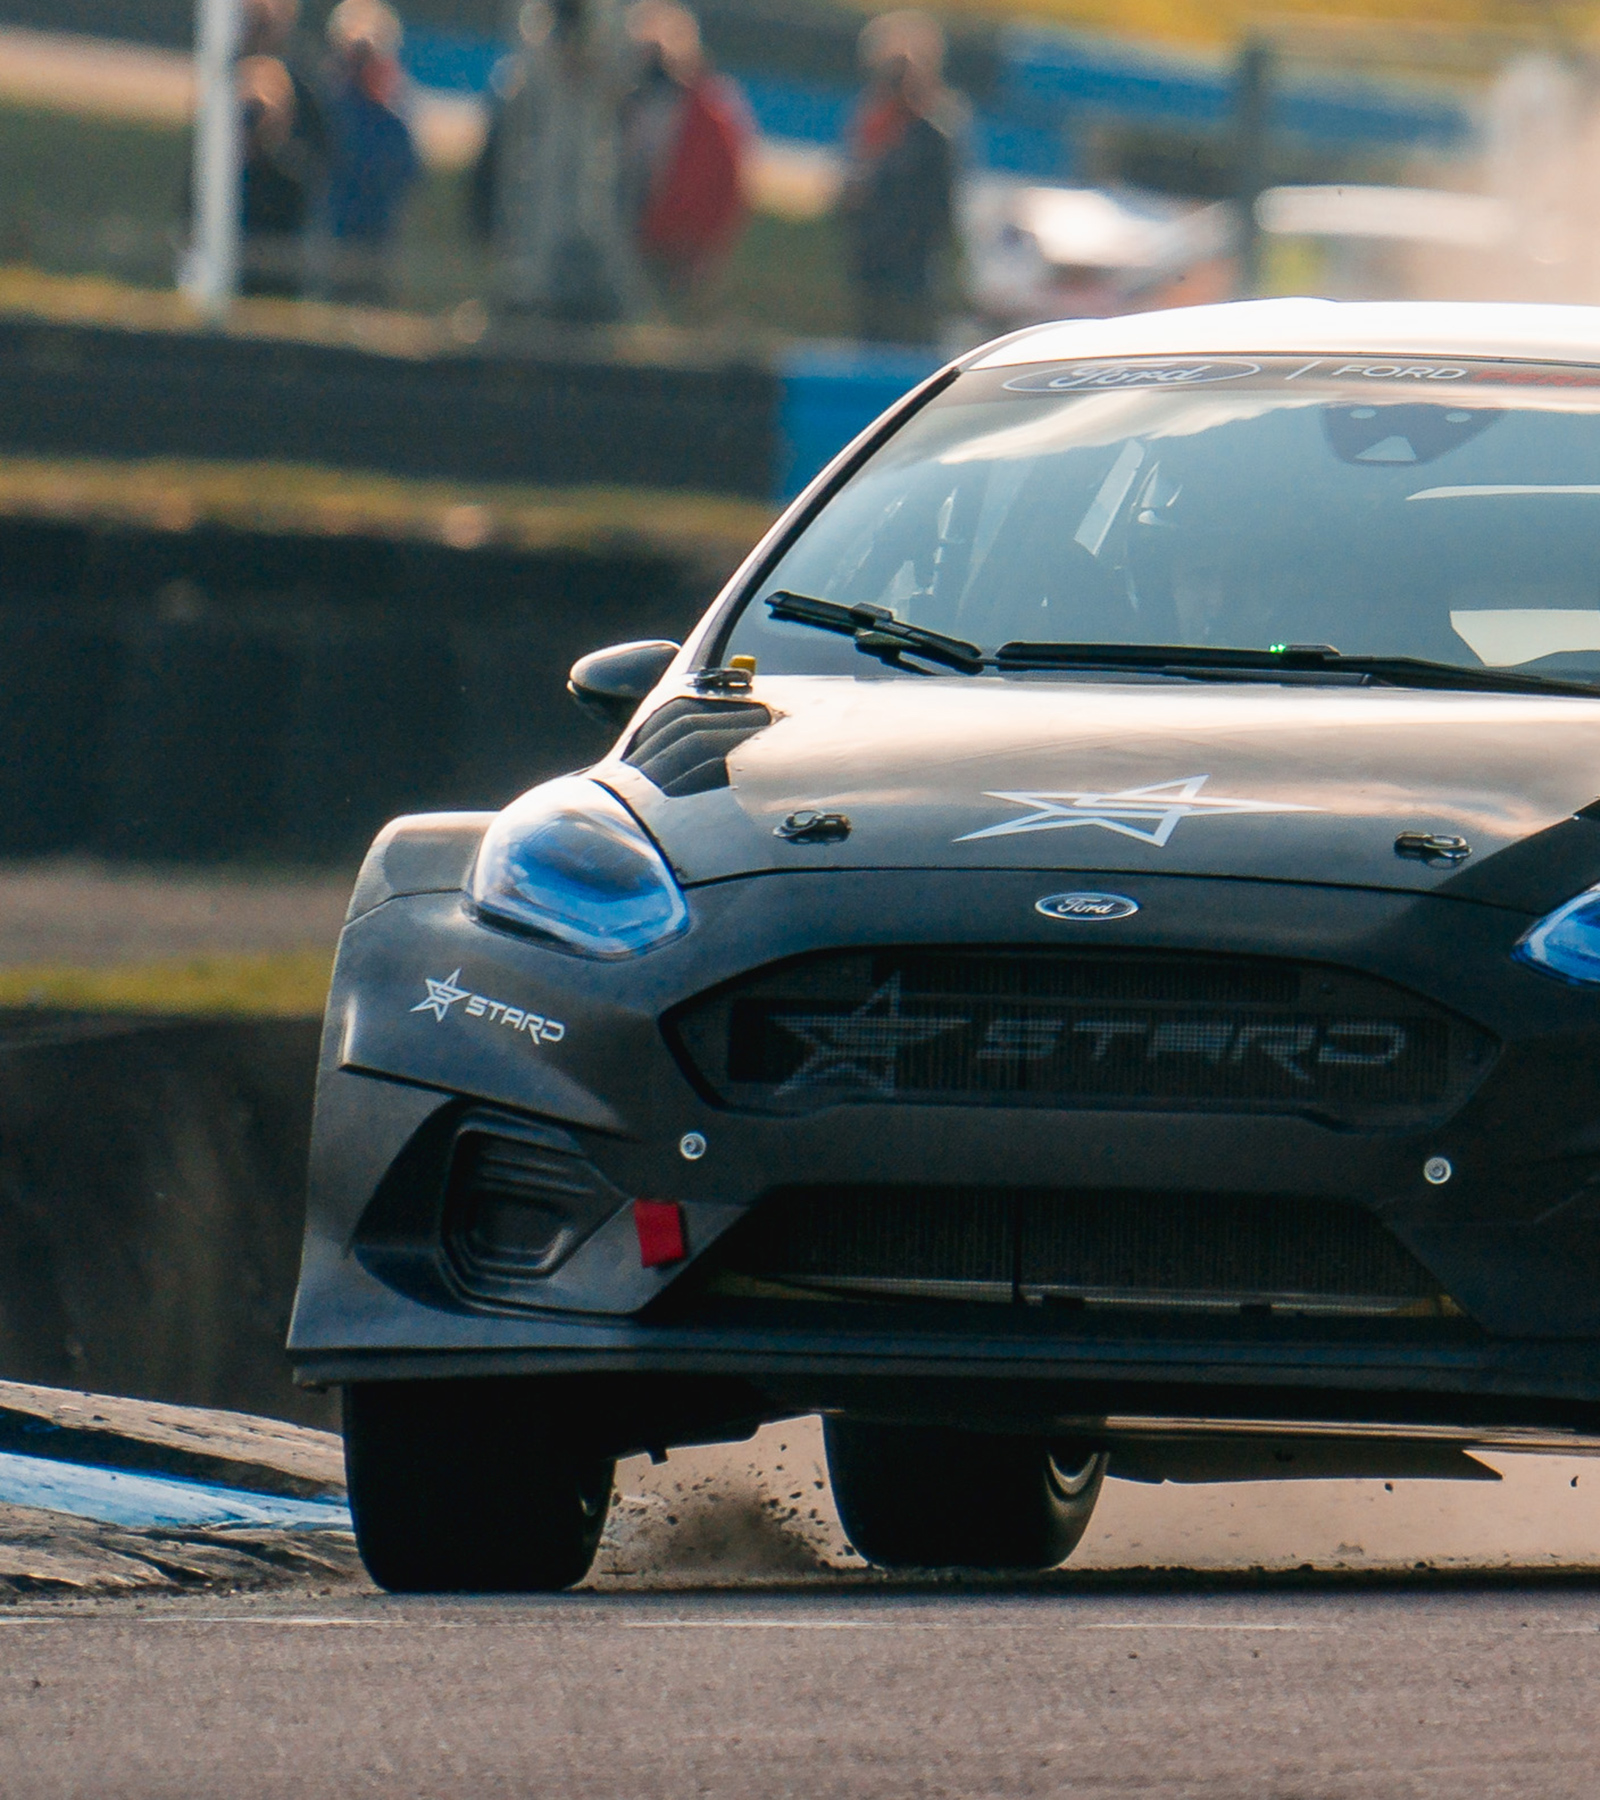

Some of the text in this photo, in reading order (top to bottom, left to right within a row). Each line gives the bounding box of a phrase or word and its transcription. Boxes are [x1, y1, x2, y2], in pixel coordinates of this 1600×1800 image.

[1047, 361, 1216, 389] Ford
[1332, 364, 1469, 380] FORD
[1056, 898, 1116, 915] Ford
[464, 995, 566, 1045] STARD
[974, 1020, 1406, 1084] STARD
